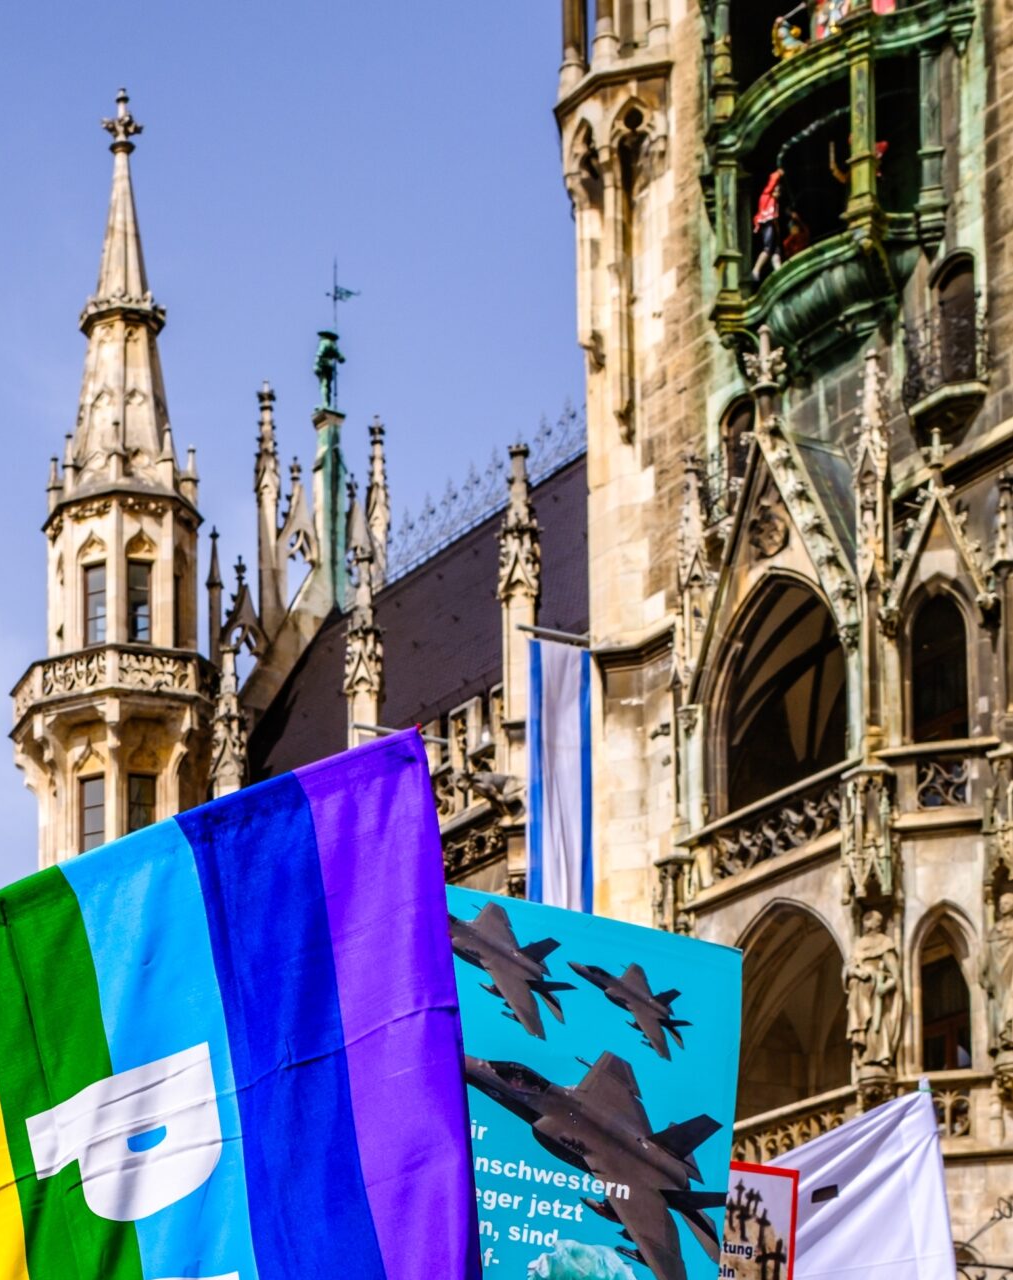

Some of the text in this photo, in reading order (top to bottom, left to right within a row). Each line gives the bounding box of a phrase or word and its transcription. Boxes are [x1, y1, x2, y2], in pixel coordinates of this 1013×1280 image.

[471, 1119, 488, 1140] ir
[475, 1156, 630, 1200] nschwestern
[527, 1194, 584, 1222] jetzt
[479, 1220, 559, 1247] n, sind
[723, 1242, 753, 1259] tung
